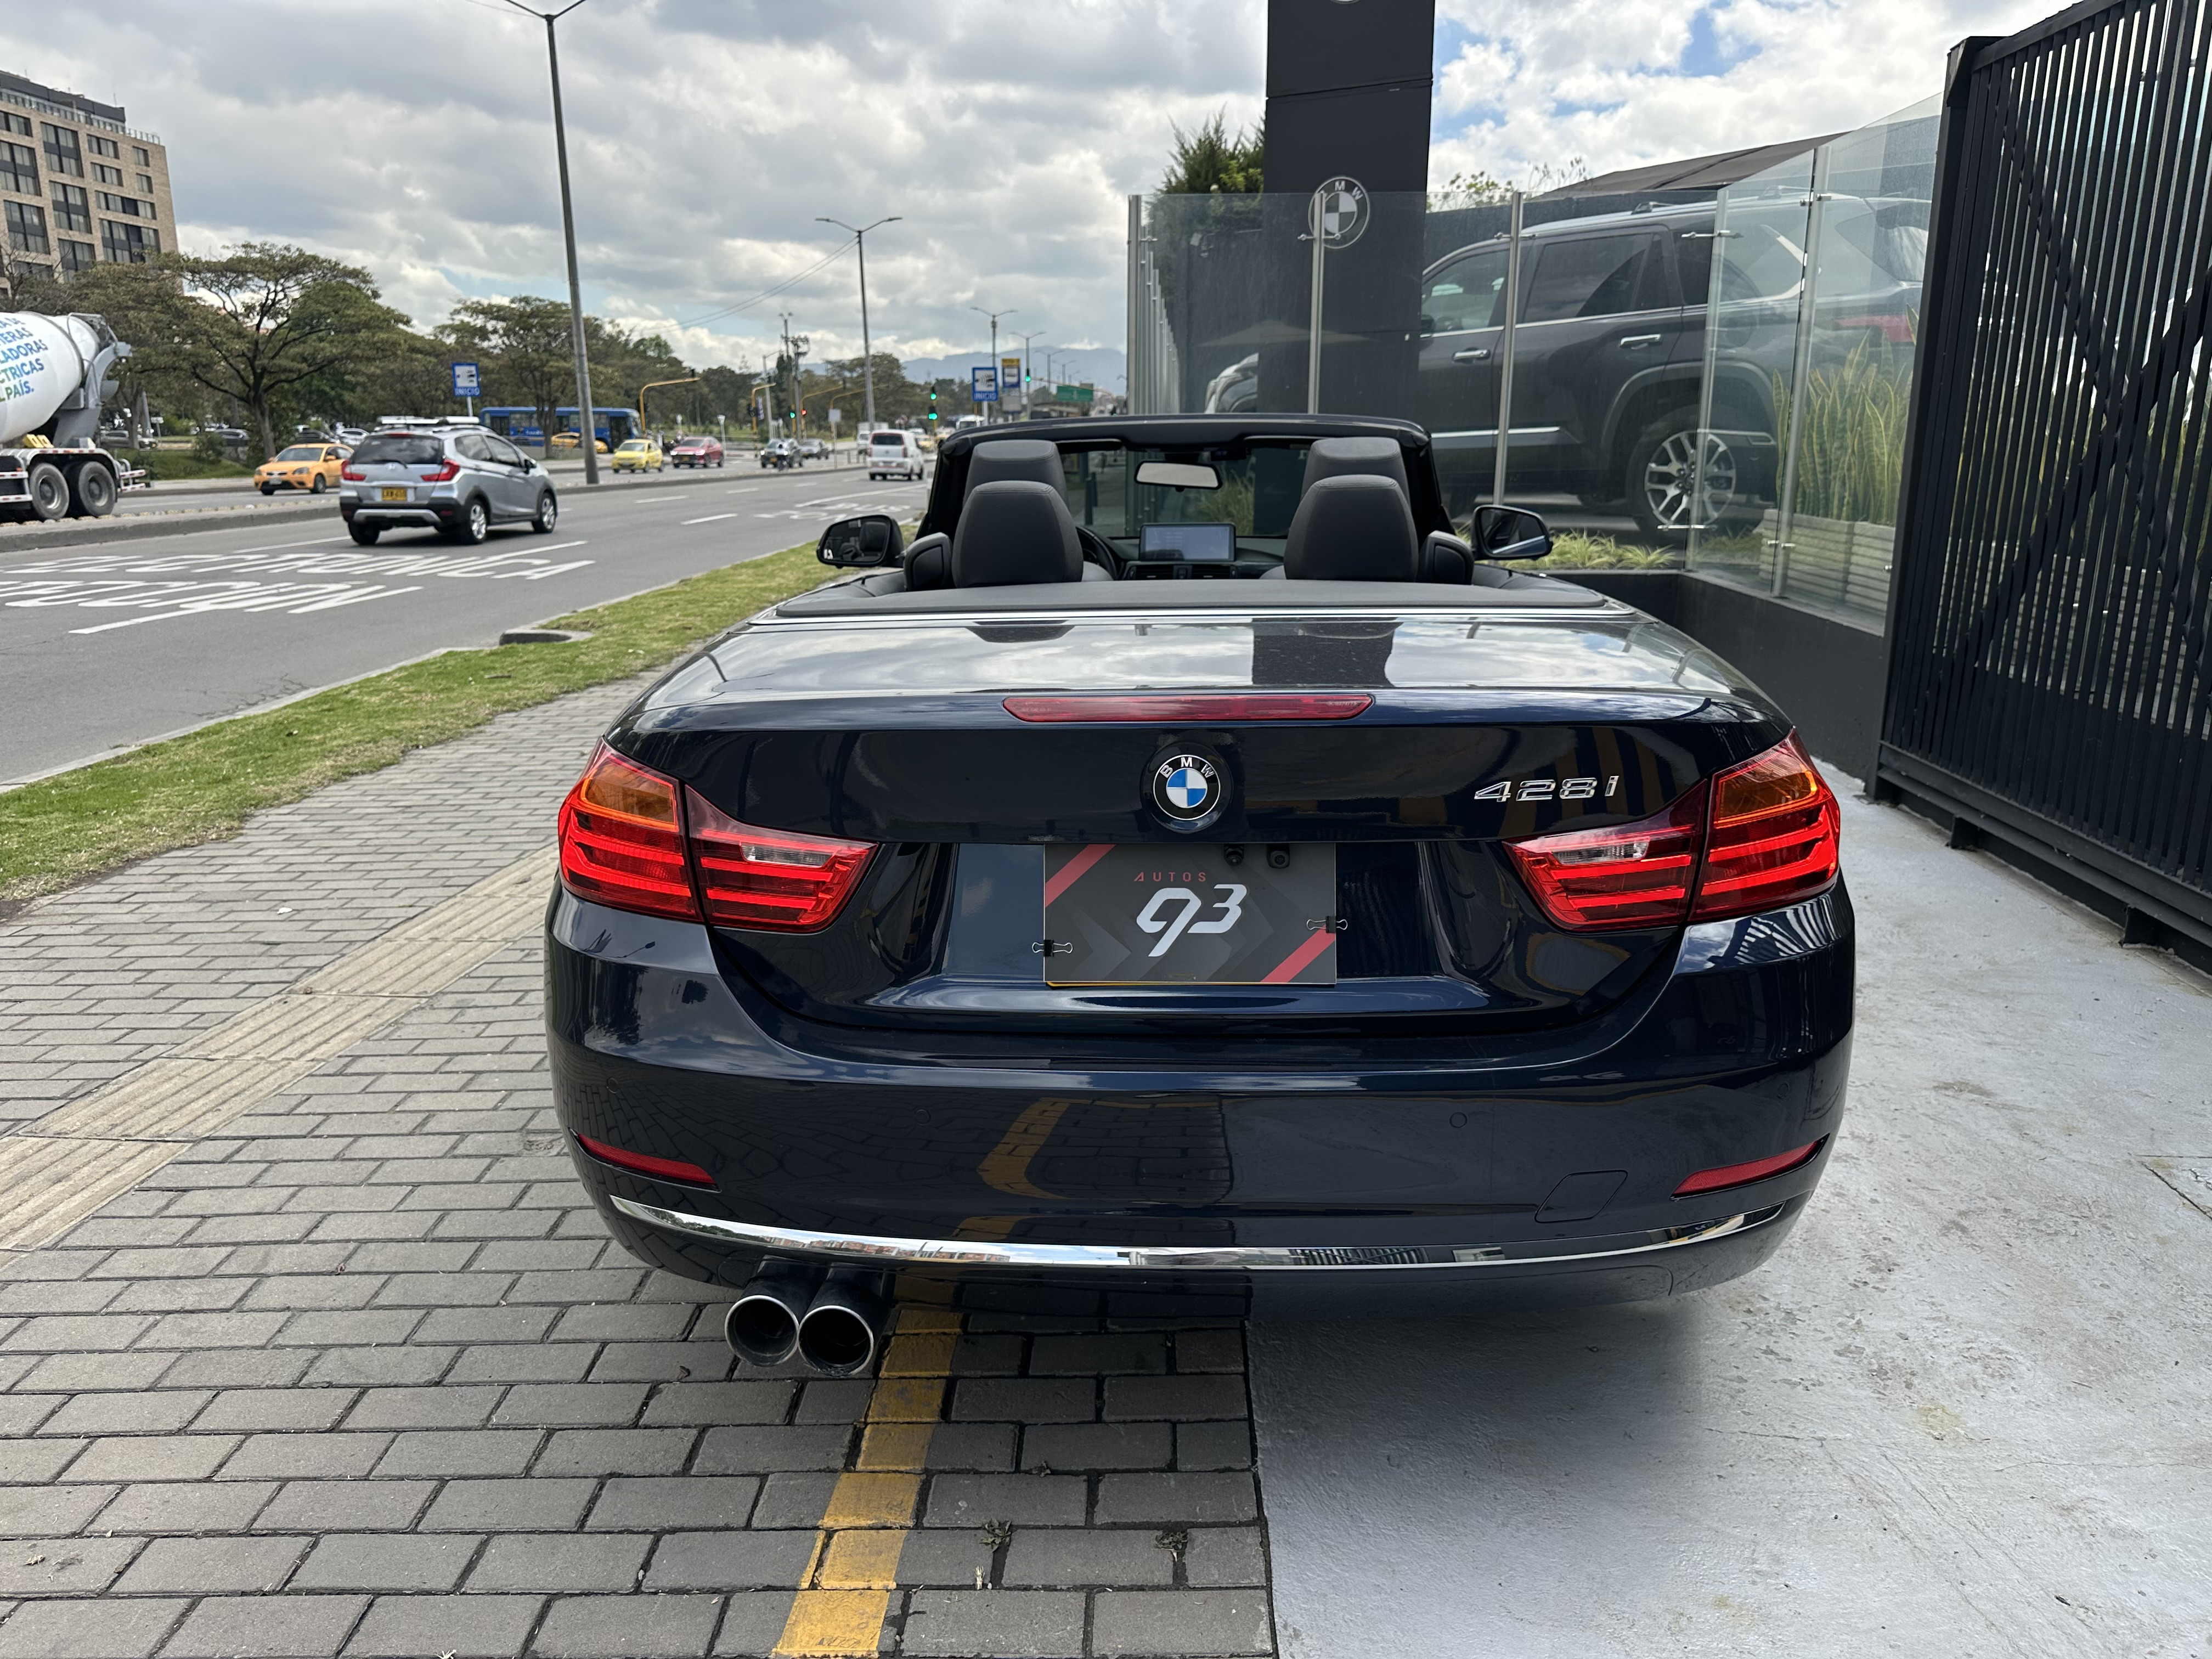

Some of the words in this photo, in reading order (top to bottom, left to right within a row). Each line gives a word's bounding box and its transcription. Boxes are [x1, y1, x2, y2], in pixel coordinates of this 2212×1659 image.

[5, 380, 34, 400] PAÍS.
[823, 503, 911, 512] BUS
[1159, 757, 1215, 778] BMW
[1474, 770, 1620, 802] 428i
[1133, 872, 1207, 882] AUTOS
[1136, 884, 1248, 957] 93
